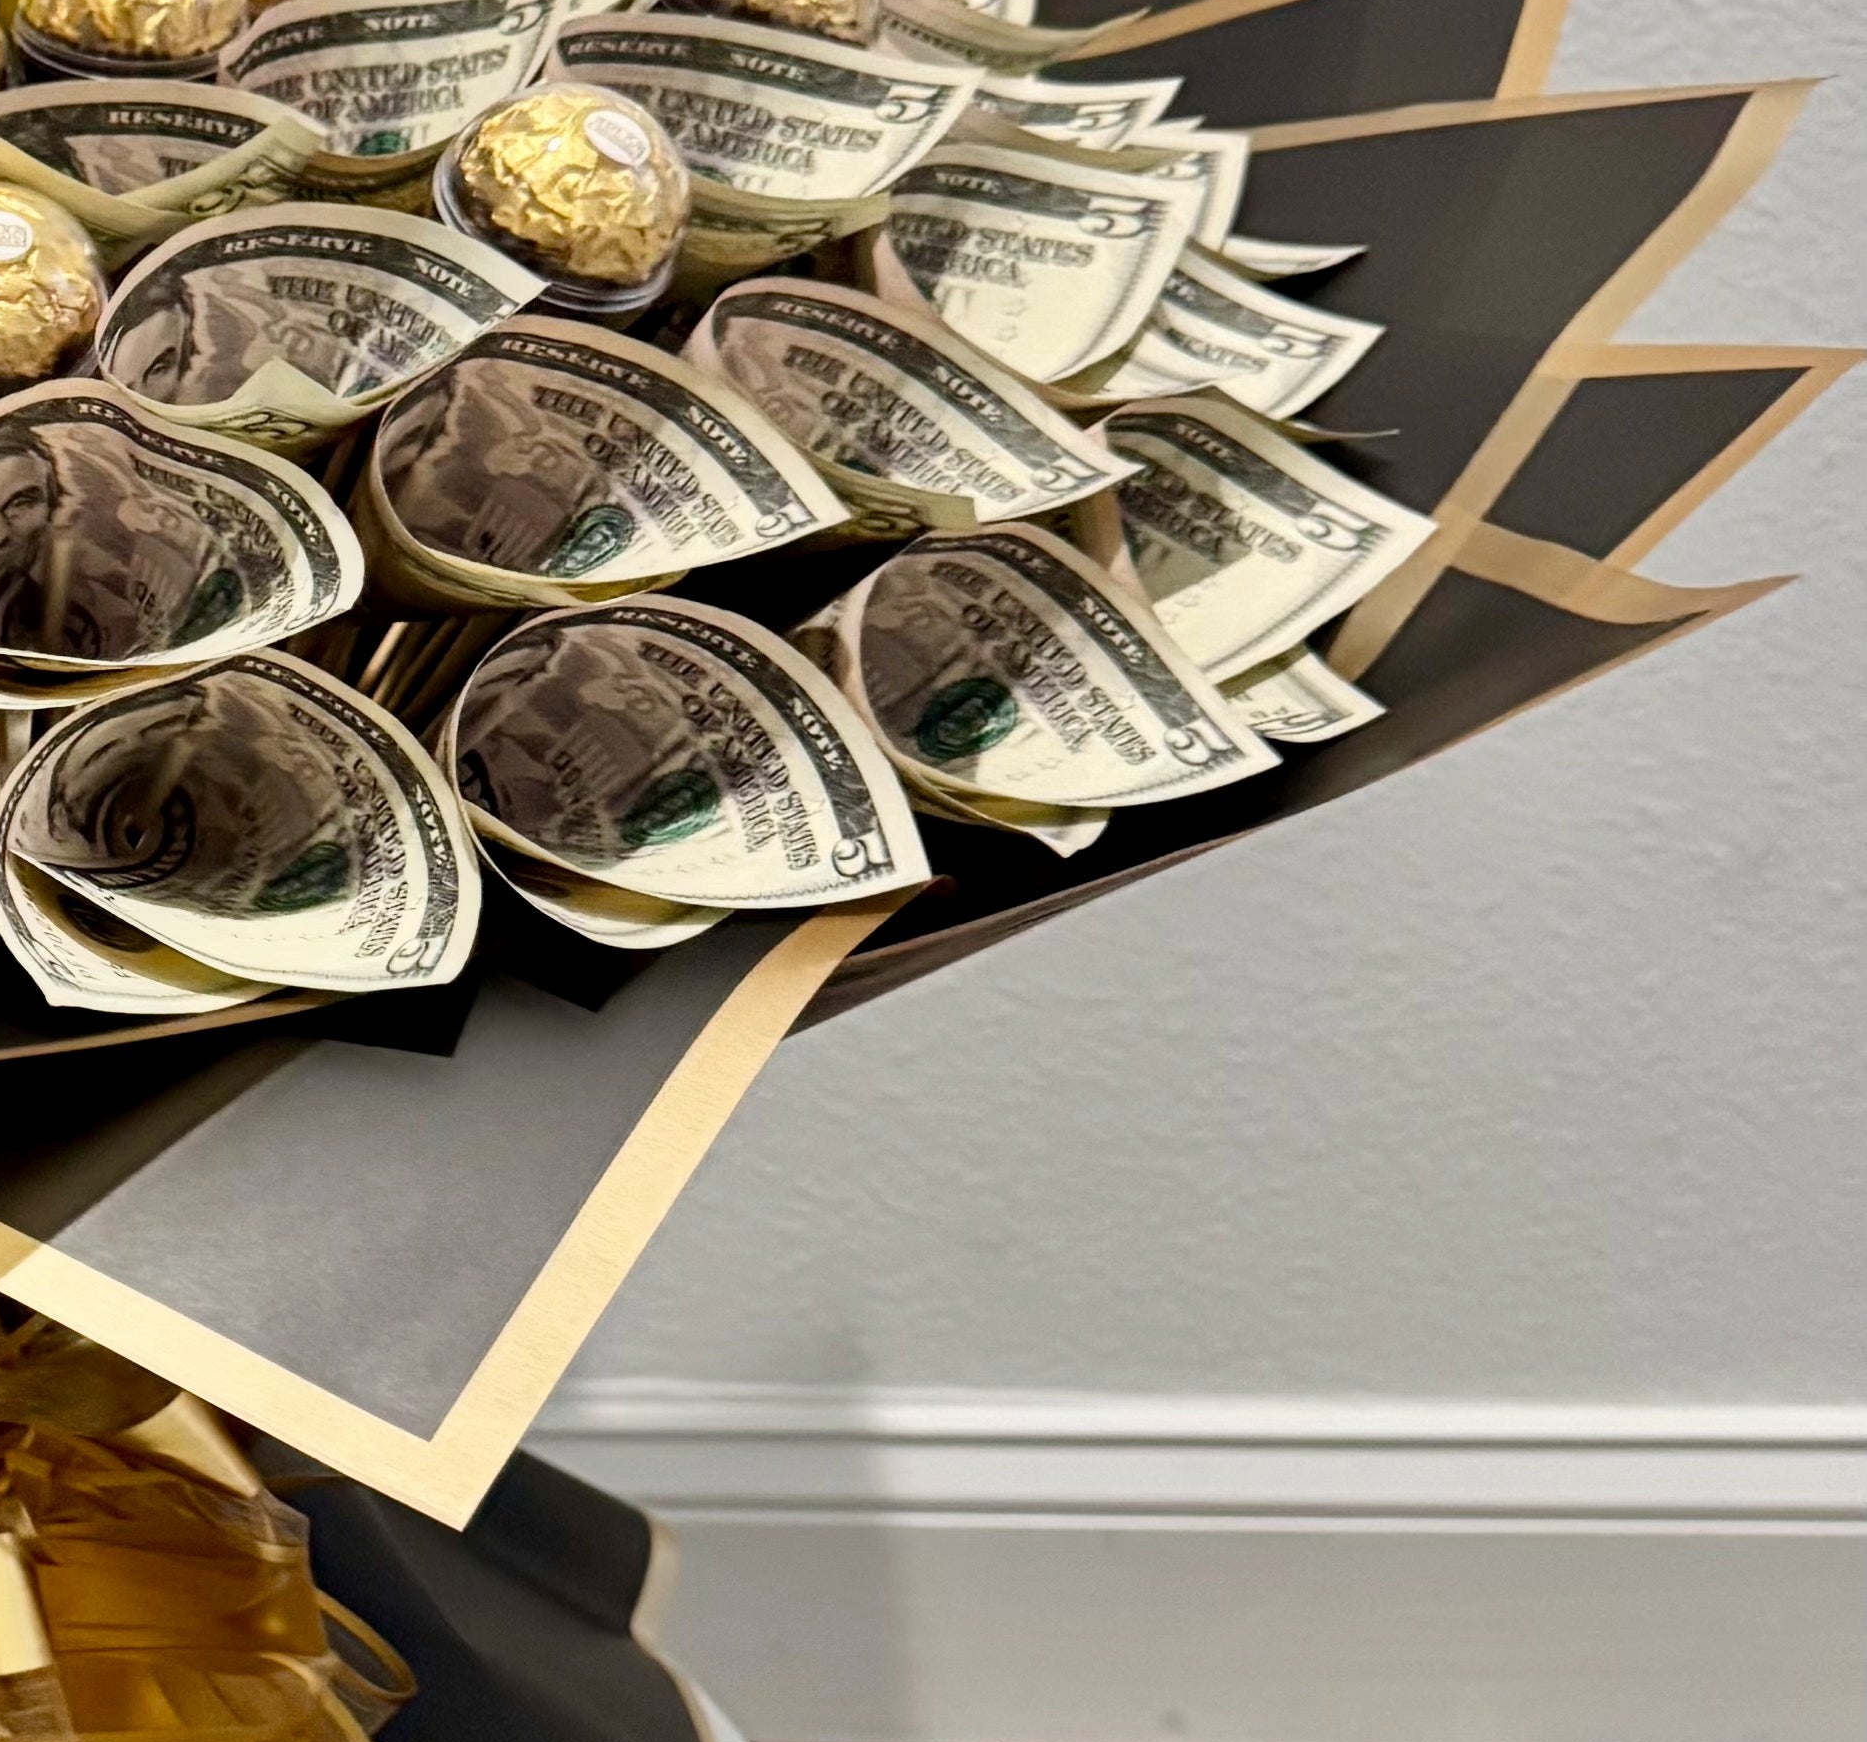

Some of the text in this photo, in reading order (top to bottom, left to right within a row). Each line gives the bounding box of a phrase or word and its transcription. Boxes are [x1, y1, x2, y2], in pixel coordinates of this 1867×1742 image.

[364, 13, 441, 33] NOTE
[107, 109, 248, 138] RESERVE
[874, 90, 947, 126] 5
[1067, 102, 1128, 133] 5
[780, 115, 884, 148] STATES
[1076, 195, 1151, 240] 5
[222, 235, 475, 298] RESERVE NOTE
[979, 227, 1096, 270] STATES
[1259, 323, 1331, 359] 5
[499, 336, 653, 390] RESERVE
[683, 403, 751, 465] NOTE
[753, 502, 820, 539] 5
[931, 363, 1007, 425] NOTE
[1030, 456, 1109, 495] 5
[1295, 499, 1376, 553] 5
[1077, 595, 1239, 769] NOTE 5
[786, 695, 841, 774] NOTE
[832, 830, 892, 879] 5
